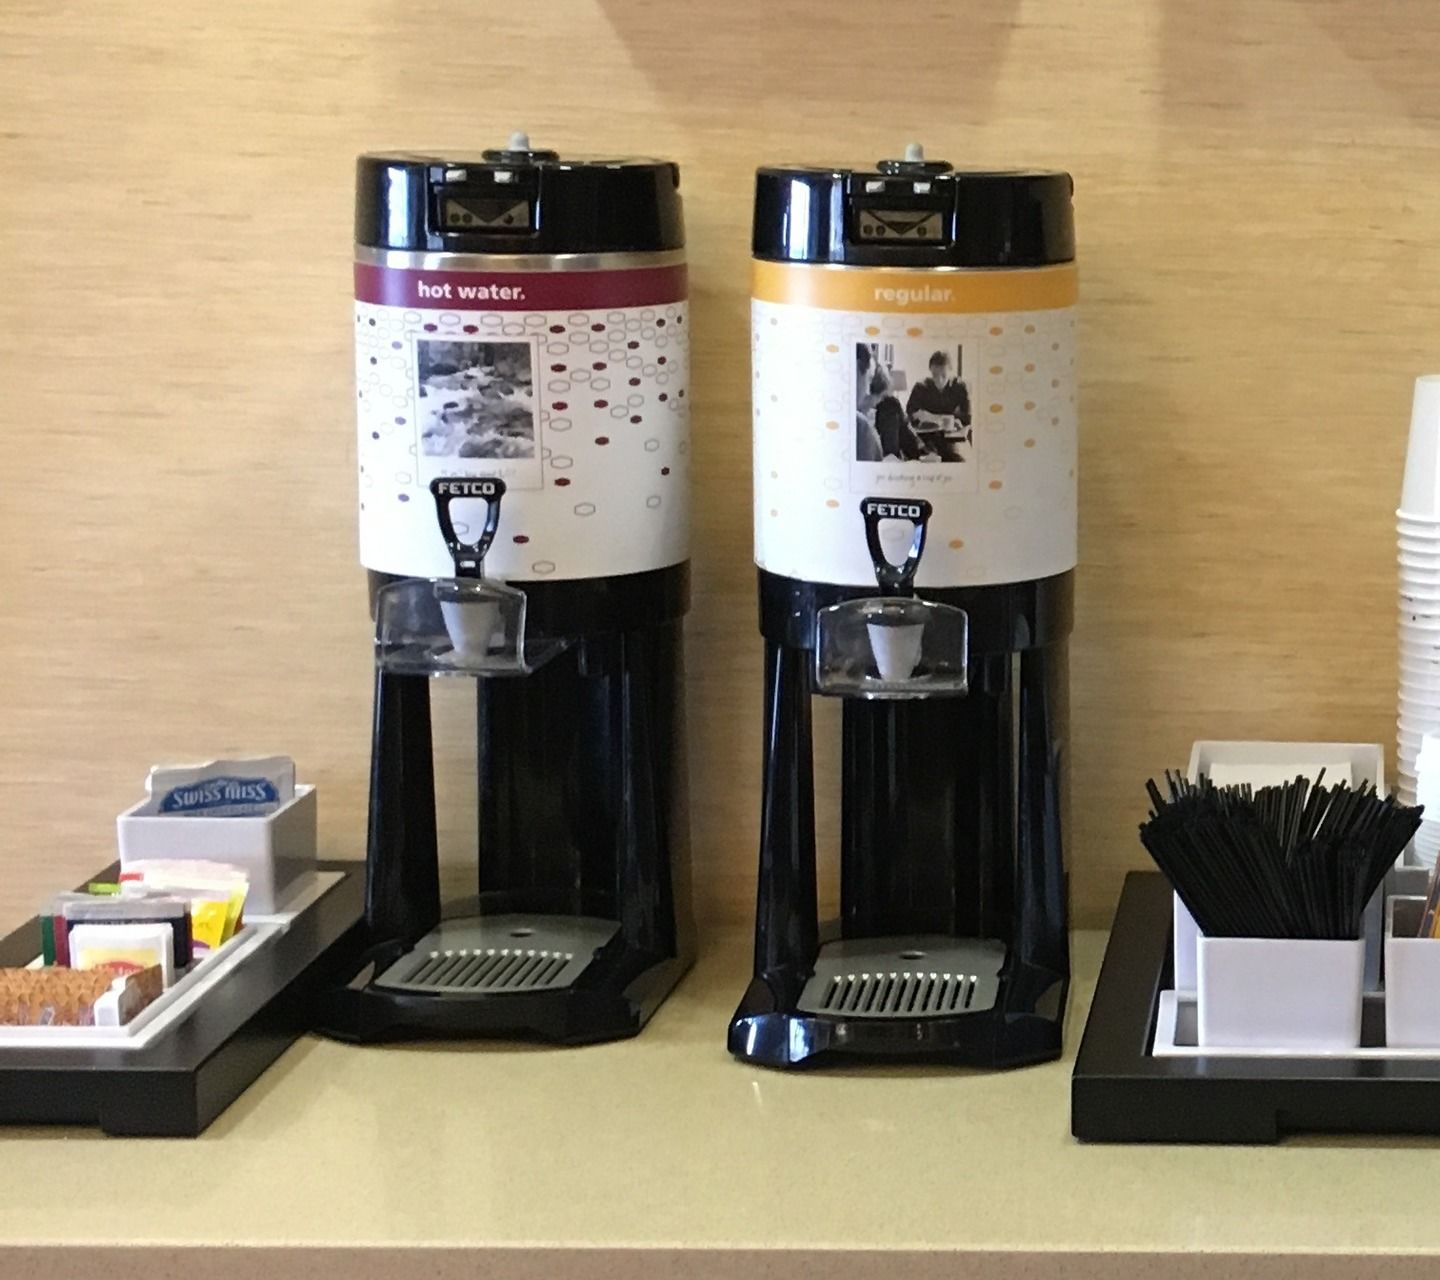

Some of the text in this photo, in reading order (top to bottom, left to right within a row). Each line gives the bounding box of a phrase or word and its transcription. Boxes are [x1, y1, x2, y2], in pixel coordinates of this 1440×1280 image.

[417, 280, 526, 300] hot water.
[874, 284, 956, 306] regular.
[438, 482, 495, 495] FETCO
[867, 503, 921, 518] FETCO
